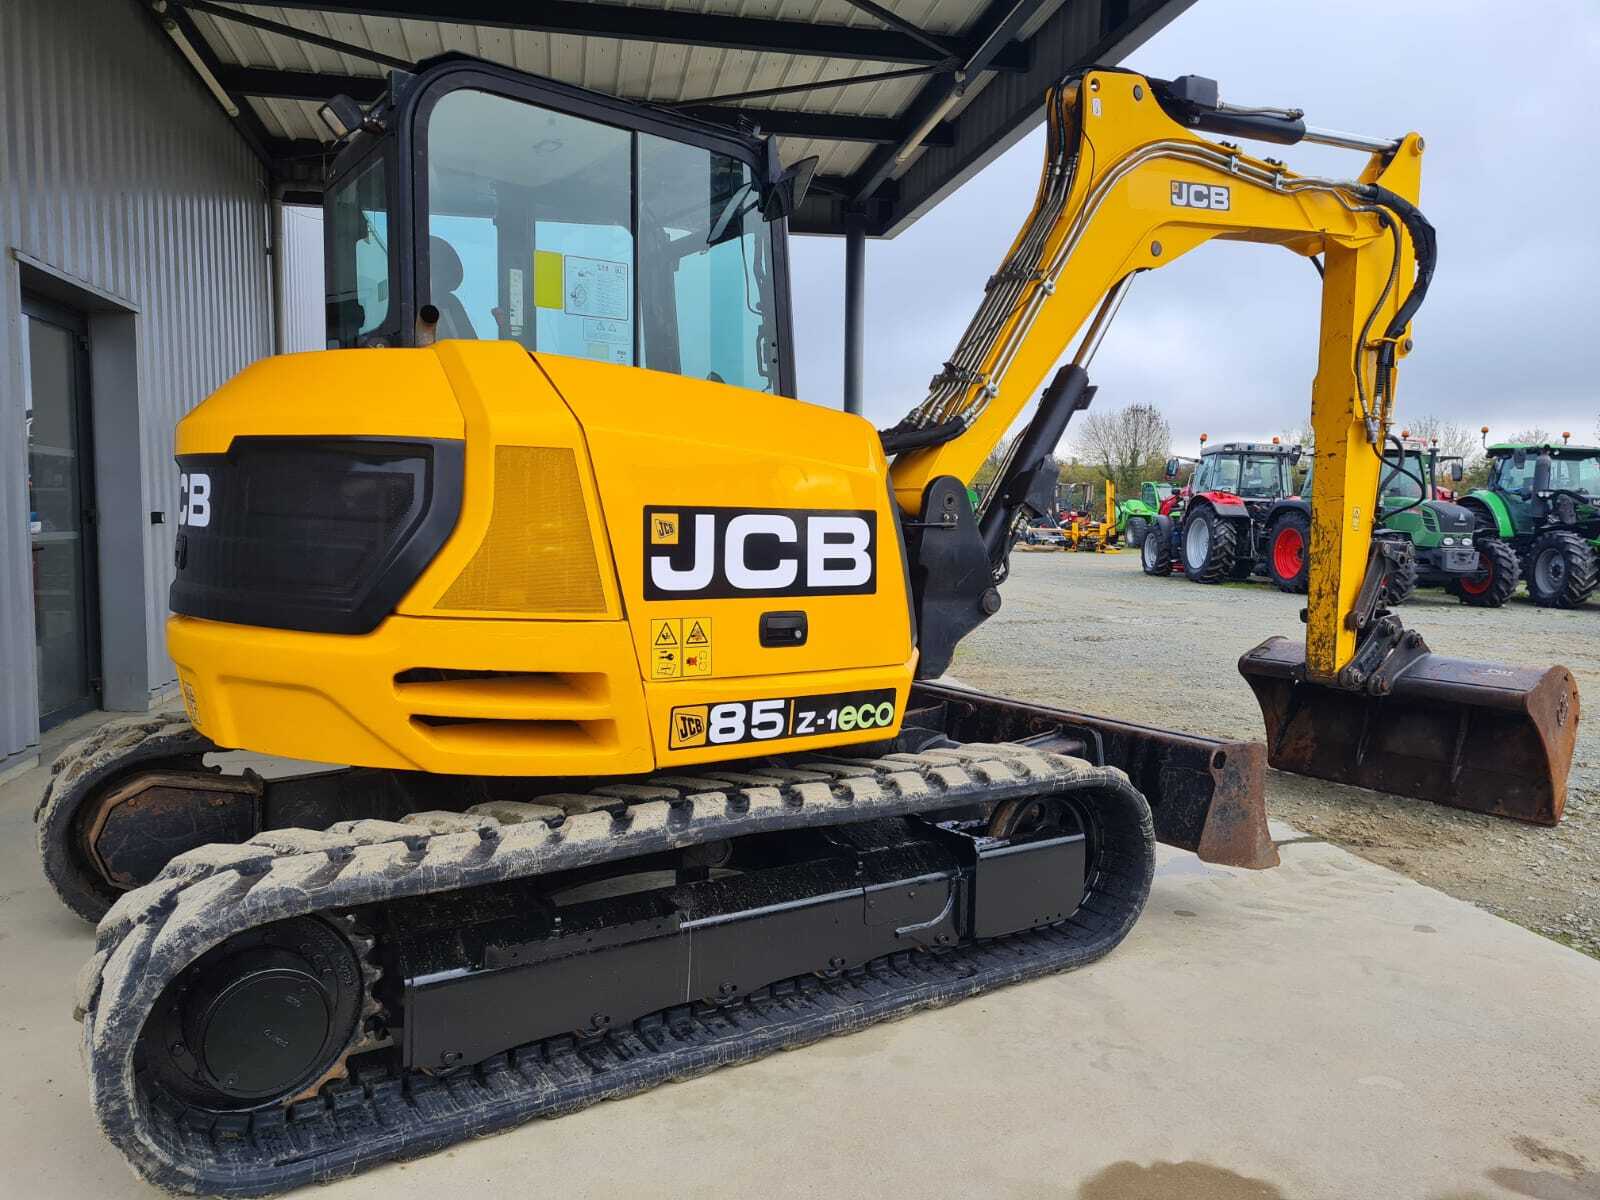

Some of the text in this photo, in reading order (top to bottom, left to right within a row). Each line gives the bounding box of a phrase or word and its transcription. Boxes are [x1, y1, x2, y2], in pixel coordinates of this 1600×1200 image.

[1172, 183, 1229, 210] JCB
[651, 513, 872, 591] JCB
[680, 715, 705, 739] JCB
[708, 700, 785, 744] 85
